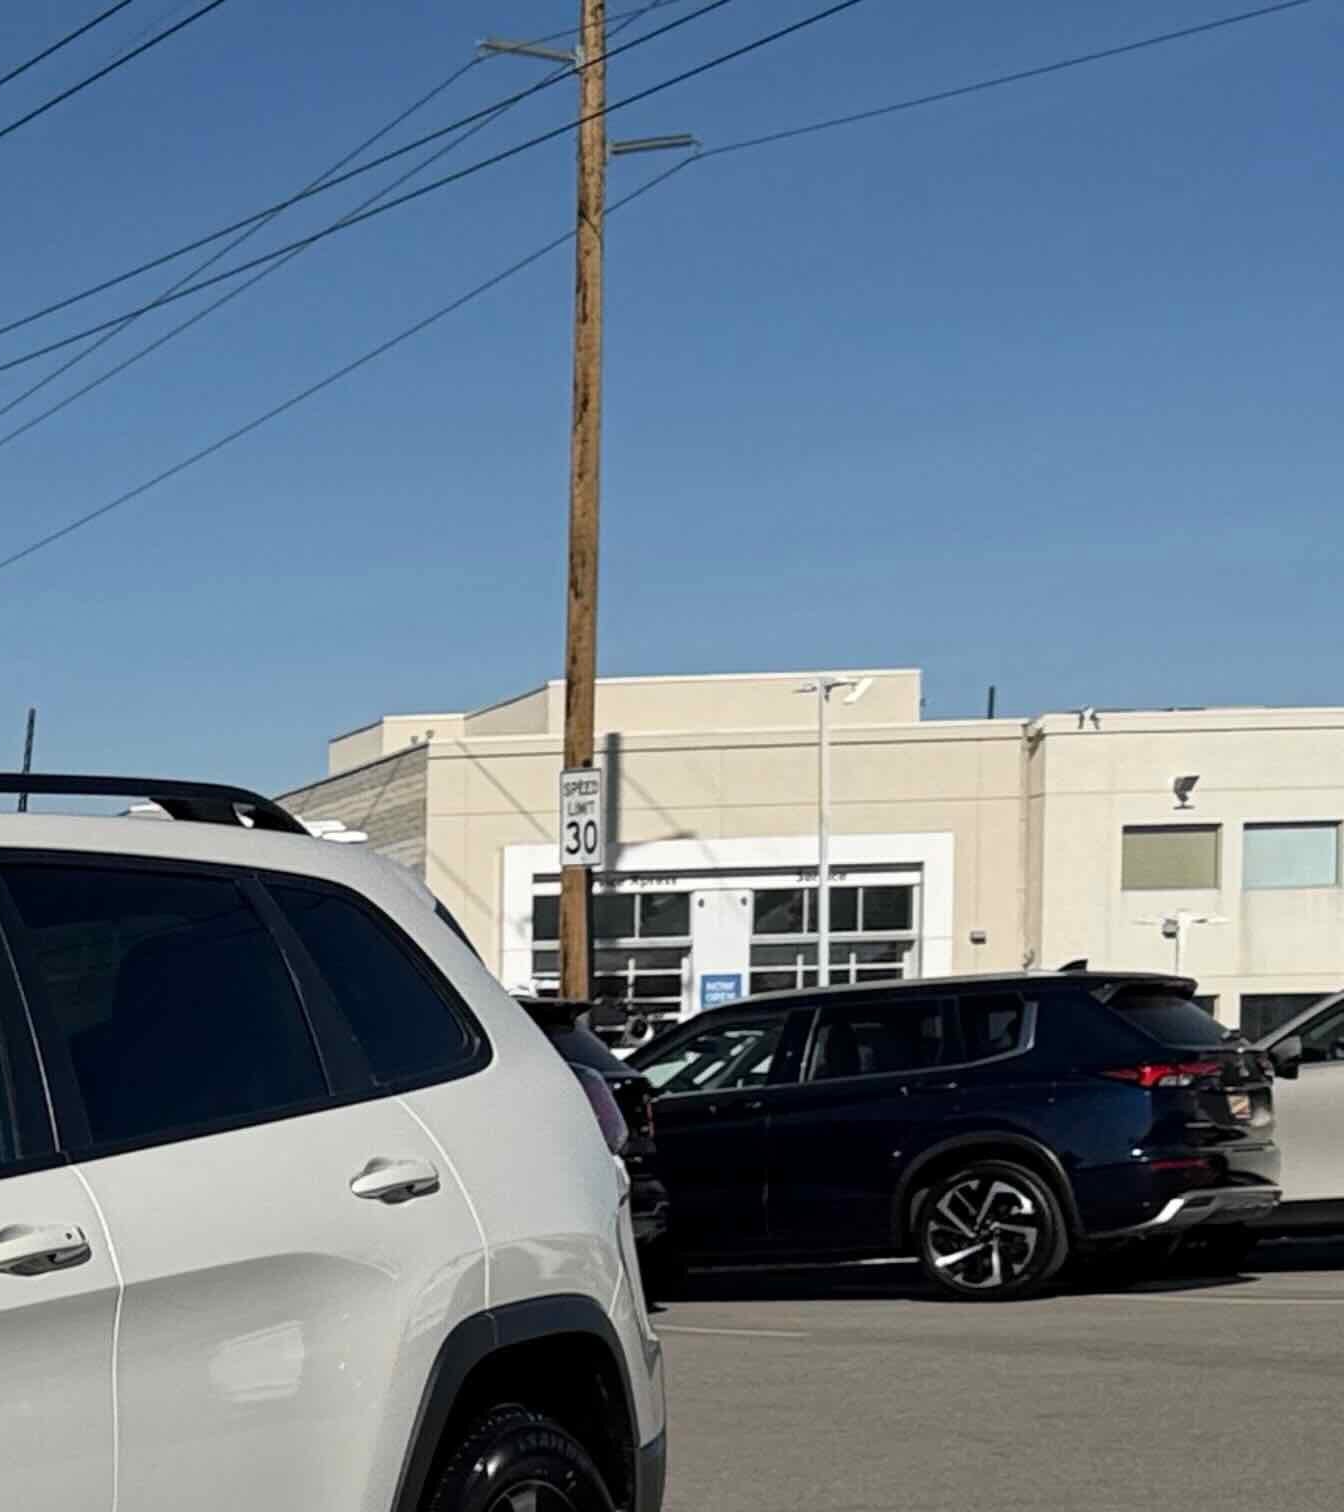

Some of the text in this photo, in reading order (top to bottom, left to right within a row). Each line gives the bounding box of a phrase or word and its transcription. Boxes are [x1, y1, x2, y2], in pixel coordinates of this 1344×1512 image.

[562, 780, 599, 797] SPEED
[568, 800, 595, 816] LIMIT
[565, 820, 598, 855] 30
